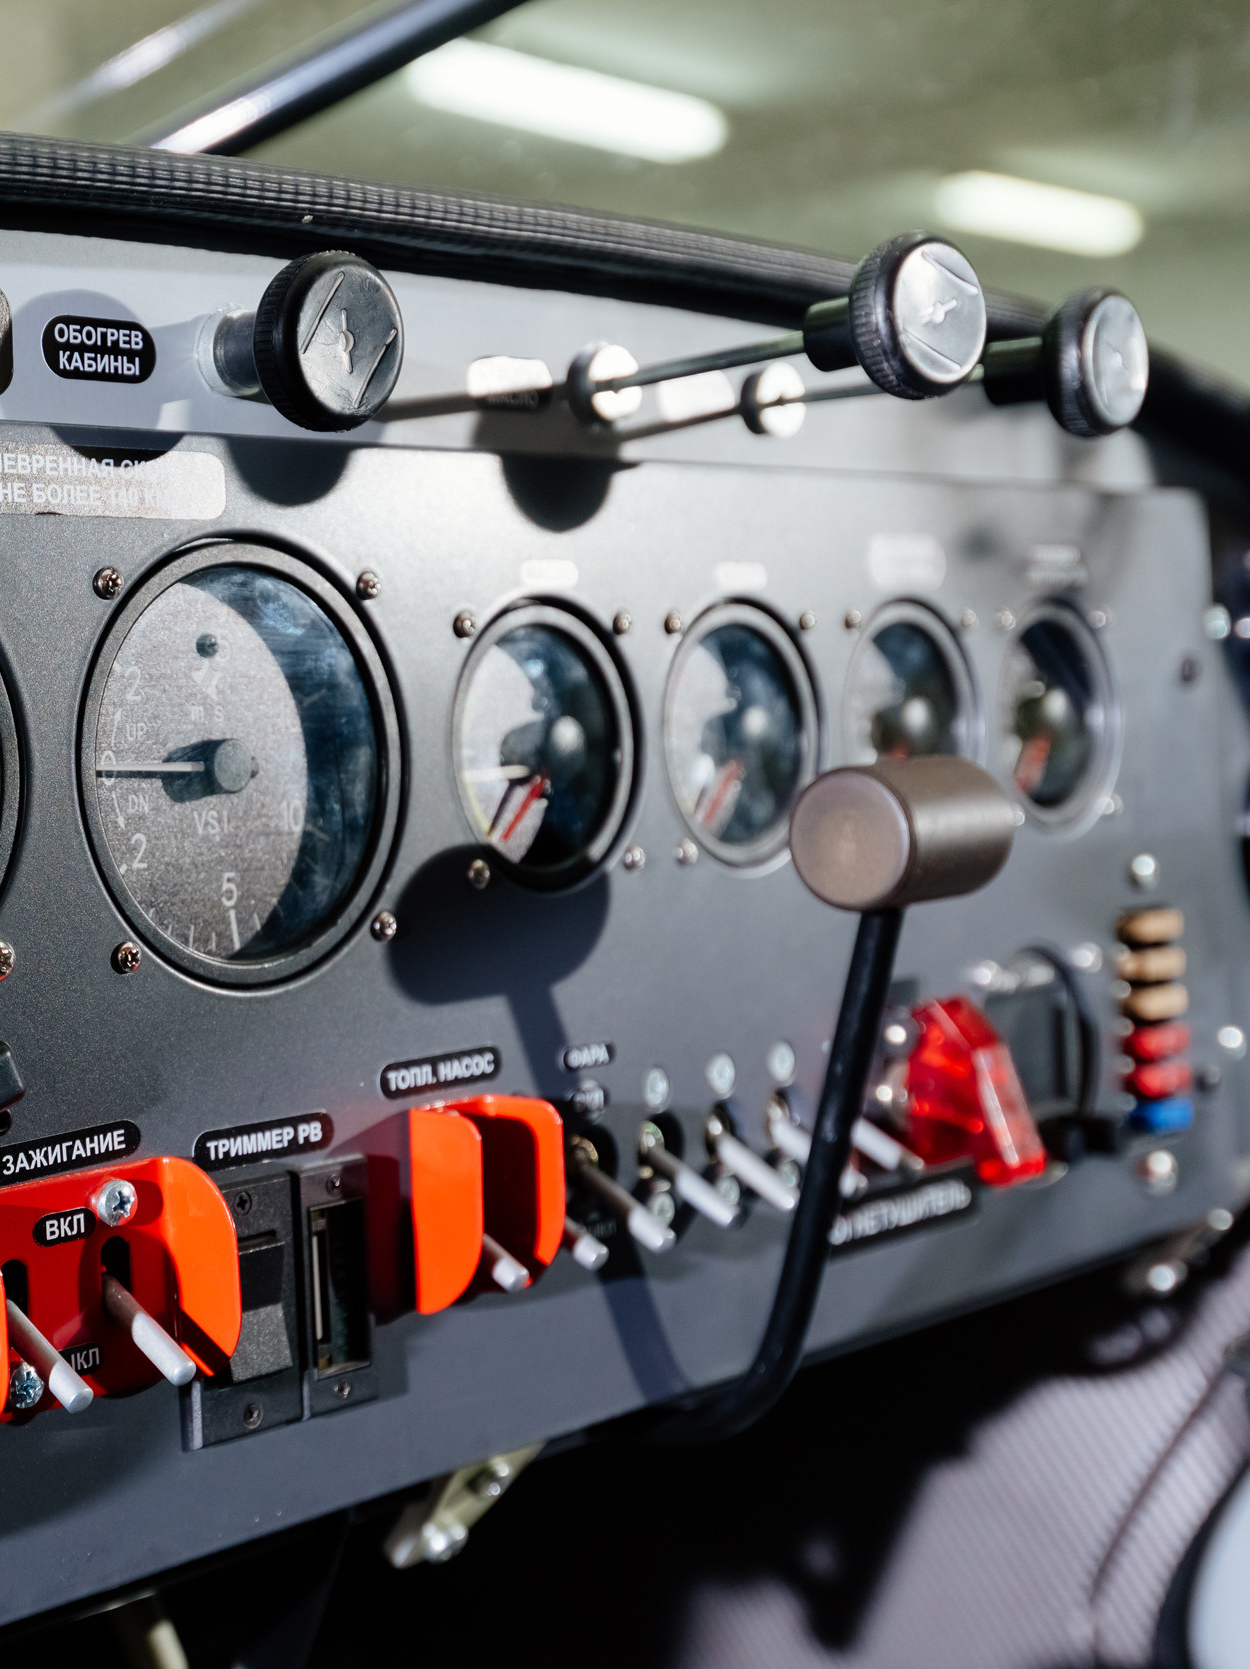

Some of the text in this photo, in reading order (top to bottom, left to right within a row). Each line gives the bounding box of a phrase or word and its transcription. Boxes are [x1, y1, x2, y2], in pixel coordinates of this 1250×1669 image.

[53, 322, 144, 350] ОБОГРЕВ
[58, 350, 140, 376] КАБИНЫ
[32, 483, 103, 507] БОЛЕЕ
[125, 722, 147, 742] UP
[127, 793, 150, 815] DN
[131, 832, 148, 869] 2
[221, 871, 238, 907] 5
[387, 1050, 495, 1092] ТОПЛ. НАСОС
[1, 1128, 127, 1177] ЗАЖИГАНИЕ
[206, 1120, 324, 1161] ТРИММЕР РВ
[44, 1212, 86, 1241] ВКЛ
